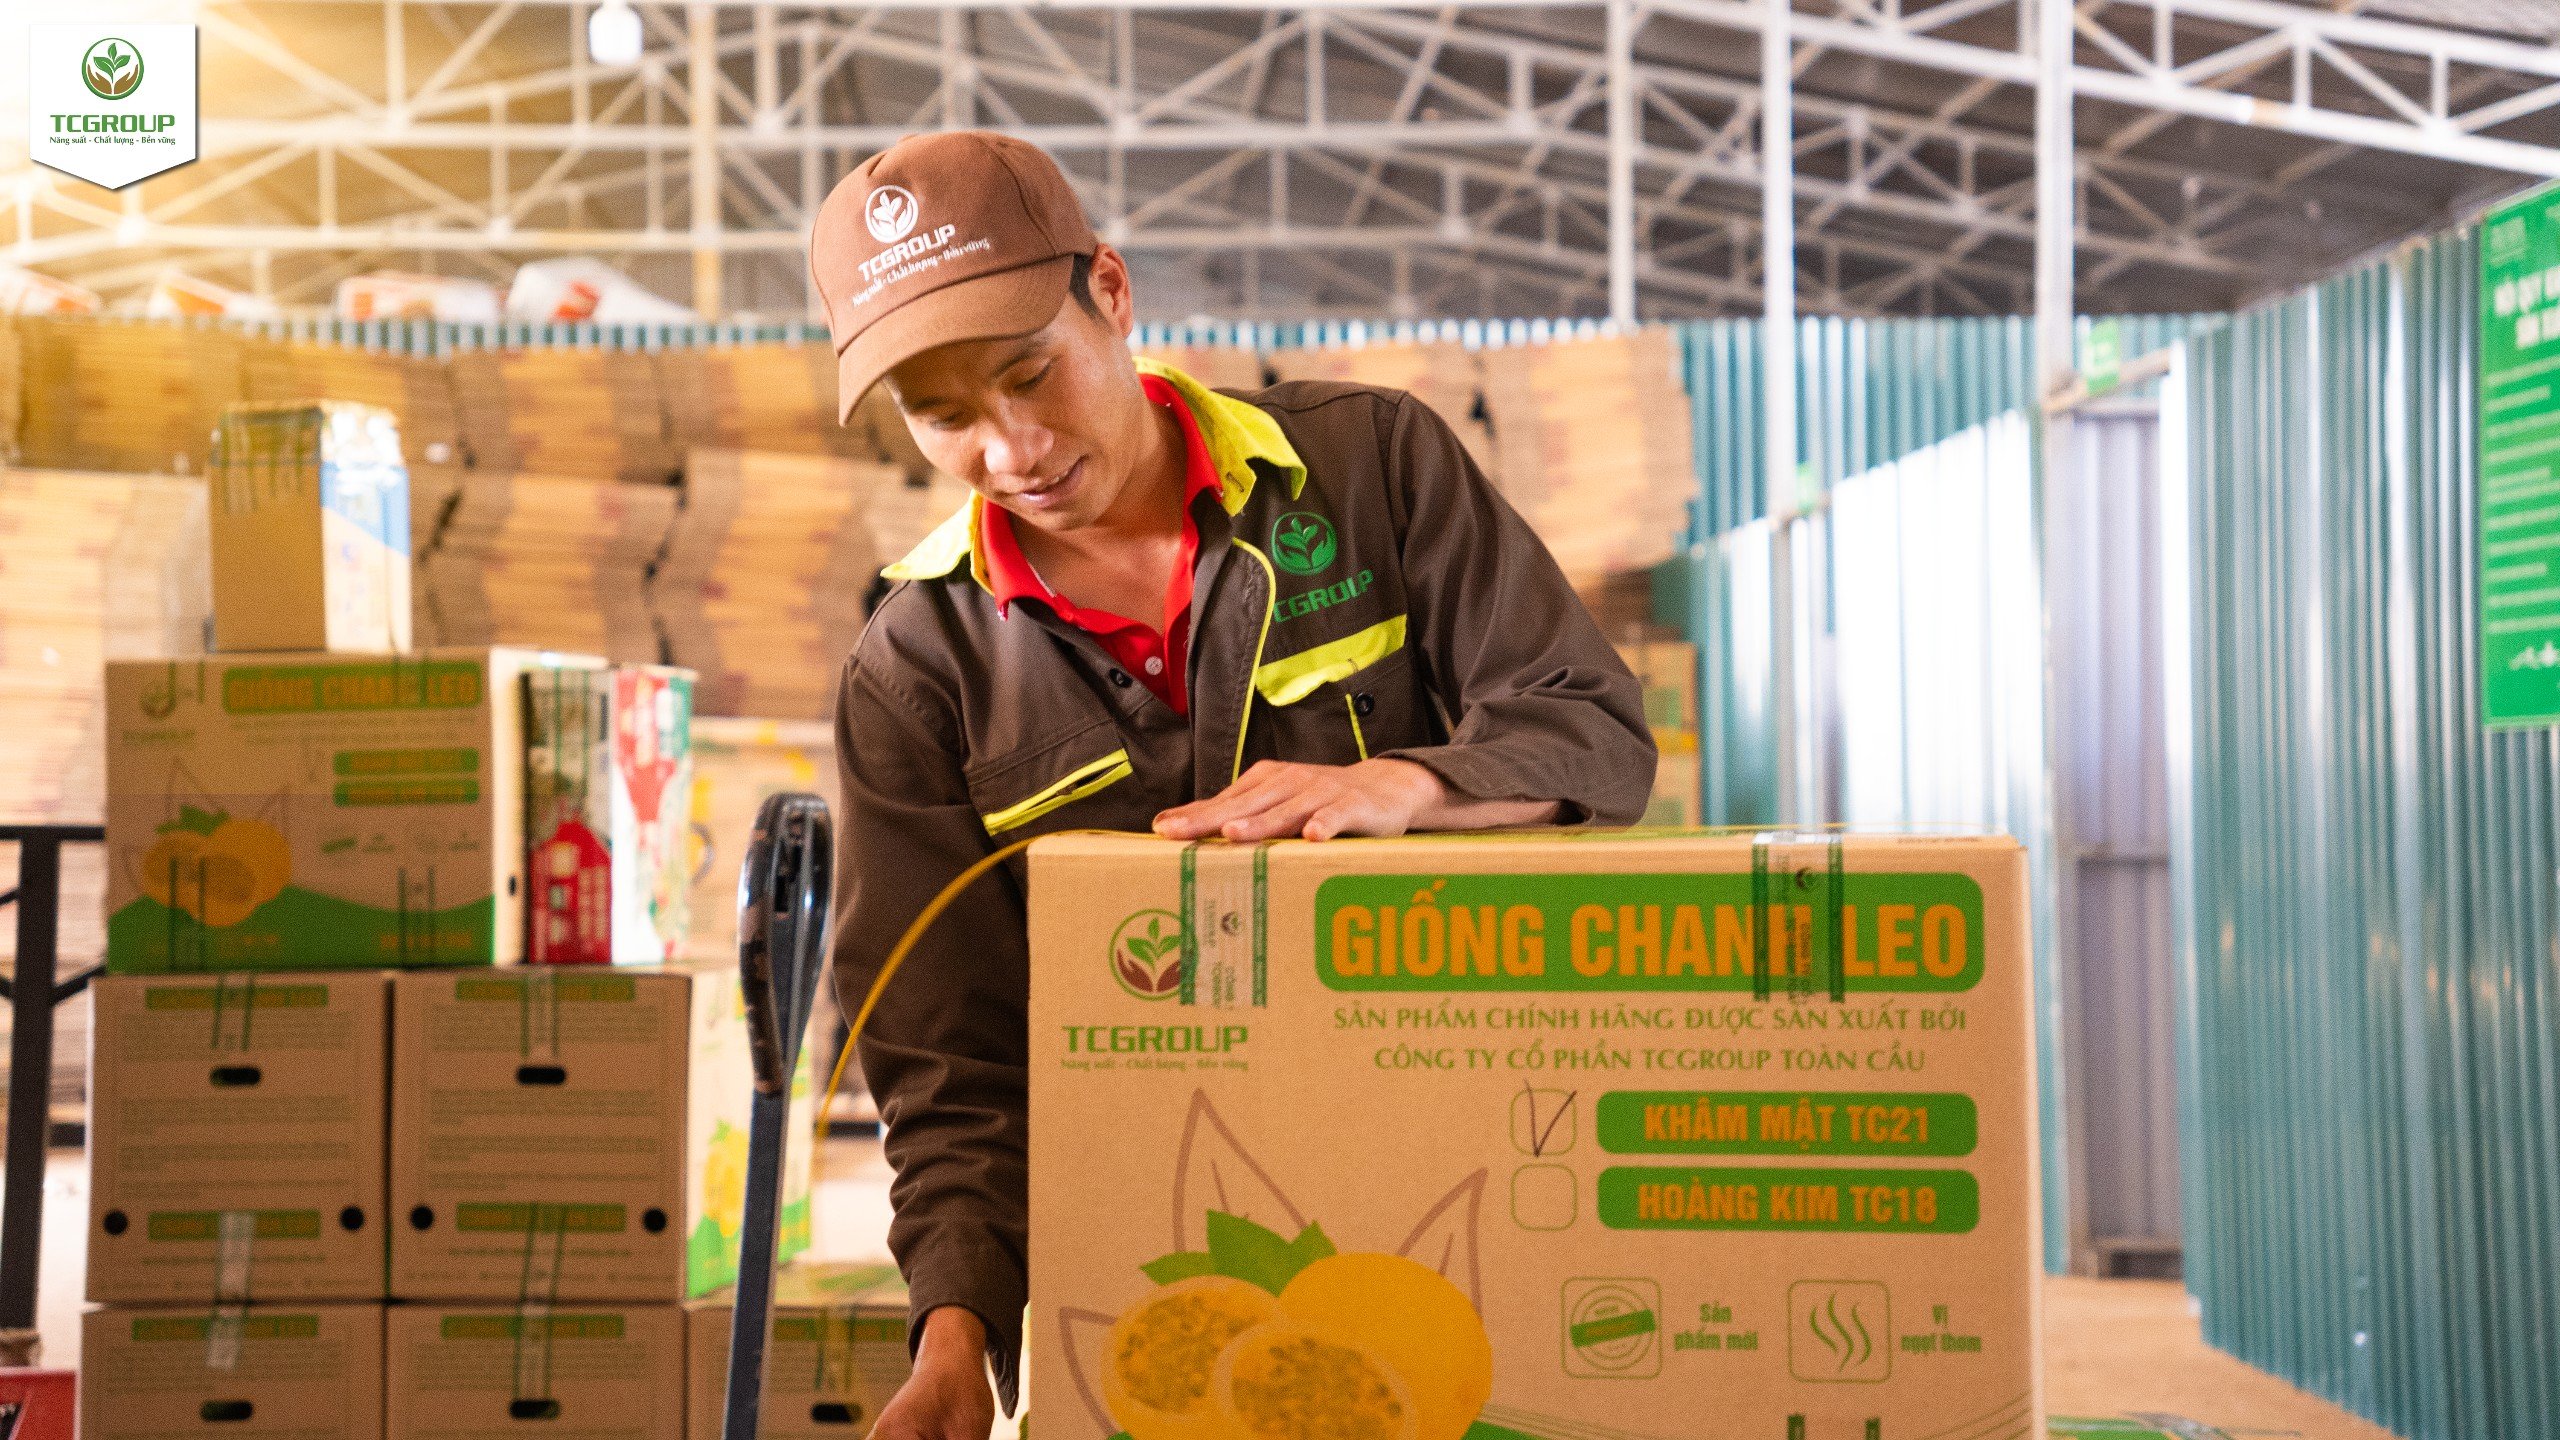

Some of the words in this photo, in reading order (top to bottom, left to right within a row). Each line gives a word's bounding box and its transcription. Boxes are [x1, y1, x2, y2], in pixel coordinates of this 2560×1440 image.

[858, 223, 956, 282] TCGROUP
[1273, 569, 1374, 622] CGROUP
[1332, 877, 1546, 977] GIỐNG
[1570, 903, 1812, 977] CHANH
[1842, 903, 1968, 978] LEO
[1062, 1025, 1248, 1053] TCGROUP
[1333, 999, 1387, 1030] SẢN
[1396, 997, 1477, 1029] PHẨM
[1485, 1002, 1580, 1030] CHÍNH
[1684, 1003, 1764, 1034] ĐƯỢC
[1772, 1000, 1828, 1030] SẢN
[1838, 998, 1911, 1030] XUẤT
[1920, 1000, 1967, 1030] BỞI
[1374, 1042, 1455, 1070] CÔNG
[1464, 1048, 1498, 1070] TY
[1506, 1037, 1546, 1070] CỔ
[1553, 1038, 1632, 1070] PHẦN
[1642, 1048, 1772, 1071] TCGROUP
[1782, 1042, 1857, 1071] TOÀN
[1865, 1039, 1927, 1072] CẦU
[1644, 1096, 1749, 1142] KHÂM
[1760, 1097, 1837, 1150] MẬT
[1846, 1106, 1929, 1144] TC21
[1638, 1176, 1759, 1221] HOÀNG
[1770, 1185, 1838, 1222] KIM
[1850, 1186, 1938, 1224] TC18
